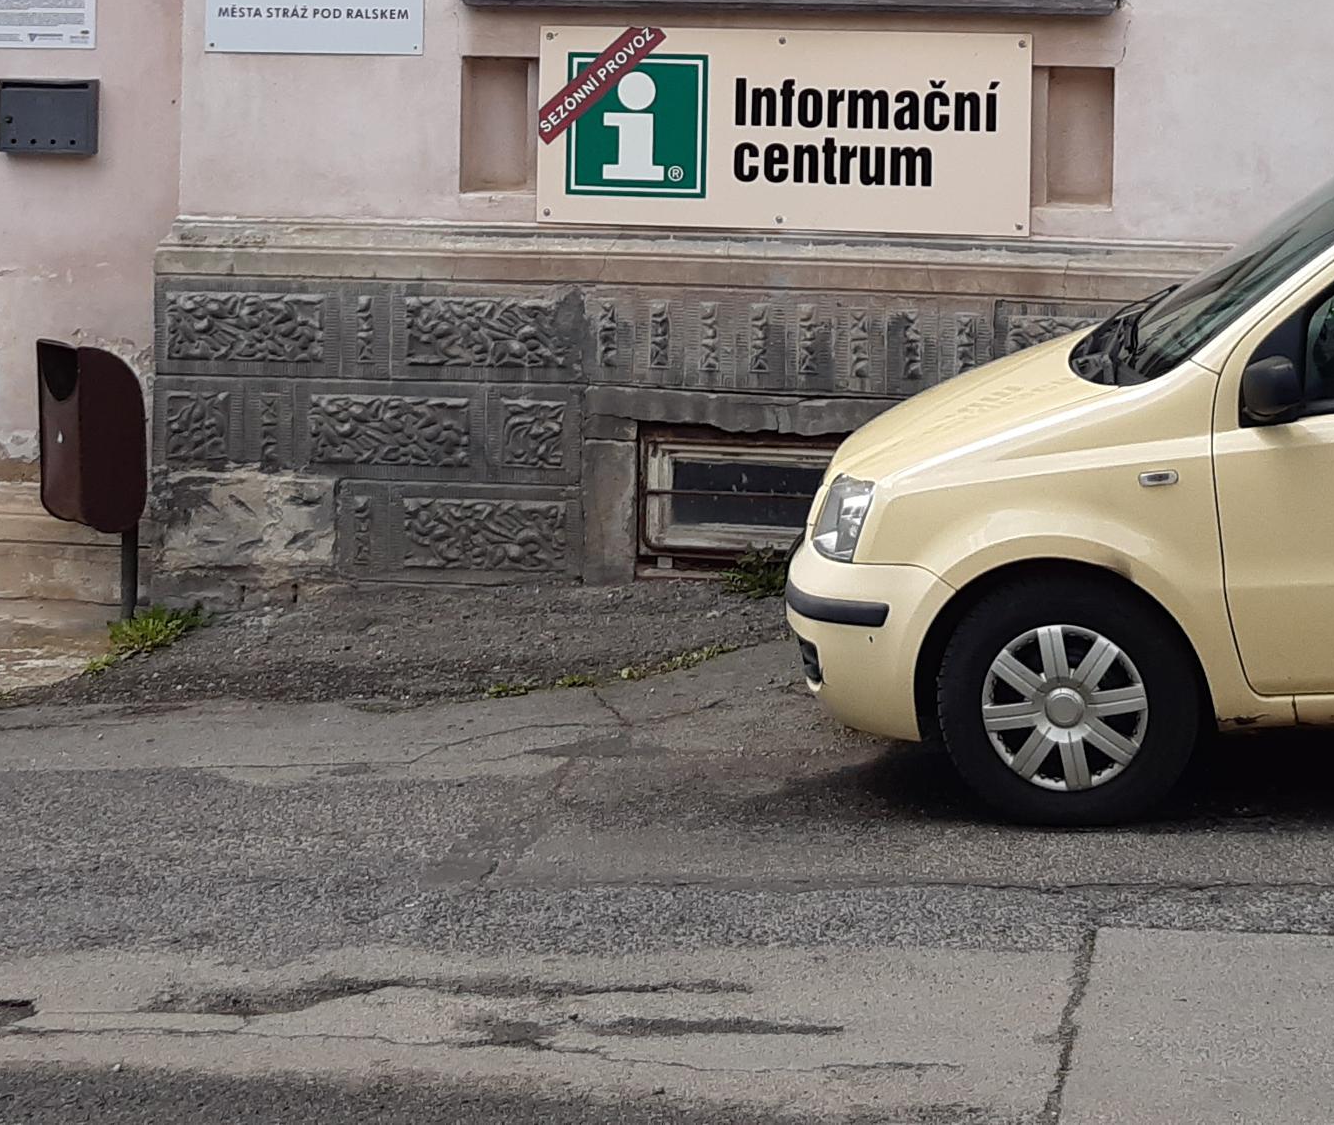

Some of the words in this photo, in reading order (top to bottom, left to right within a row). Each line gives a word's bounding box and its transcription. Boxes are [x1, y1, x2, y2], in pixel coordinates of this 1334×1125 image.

[217, 4, 263, 19] MĚSTA
[266, 4, 309, 19] STRÁŽ
[312, 7, 343, 20] POD
[346, 7, 410, 21] RALSKEM
[539, 74, 600, 133] SEZÓNNÍ
[596, 27, 655, 81] PROVOZ
[734, 77, 1001, 132] Informační
[733, 136, 933, 187] centrum
